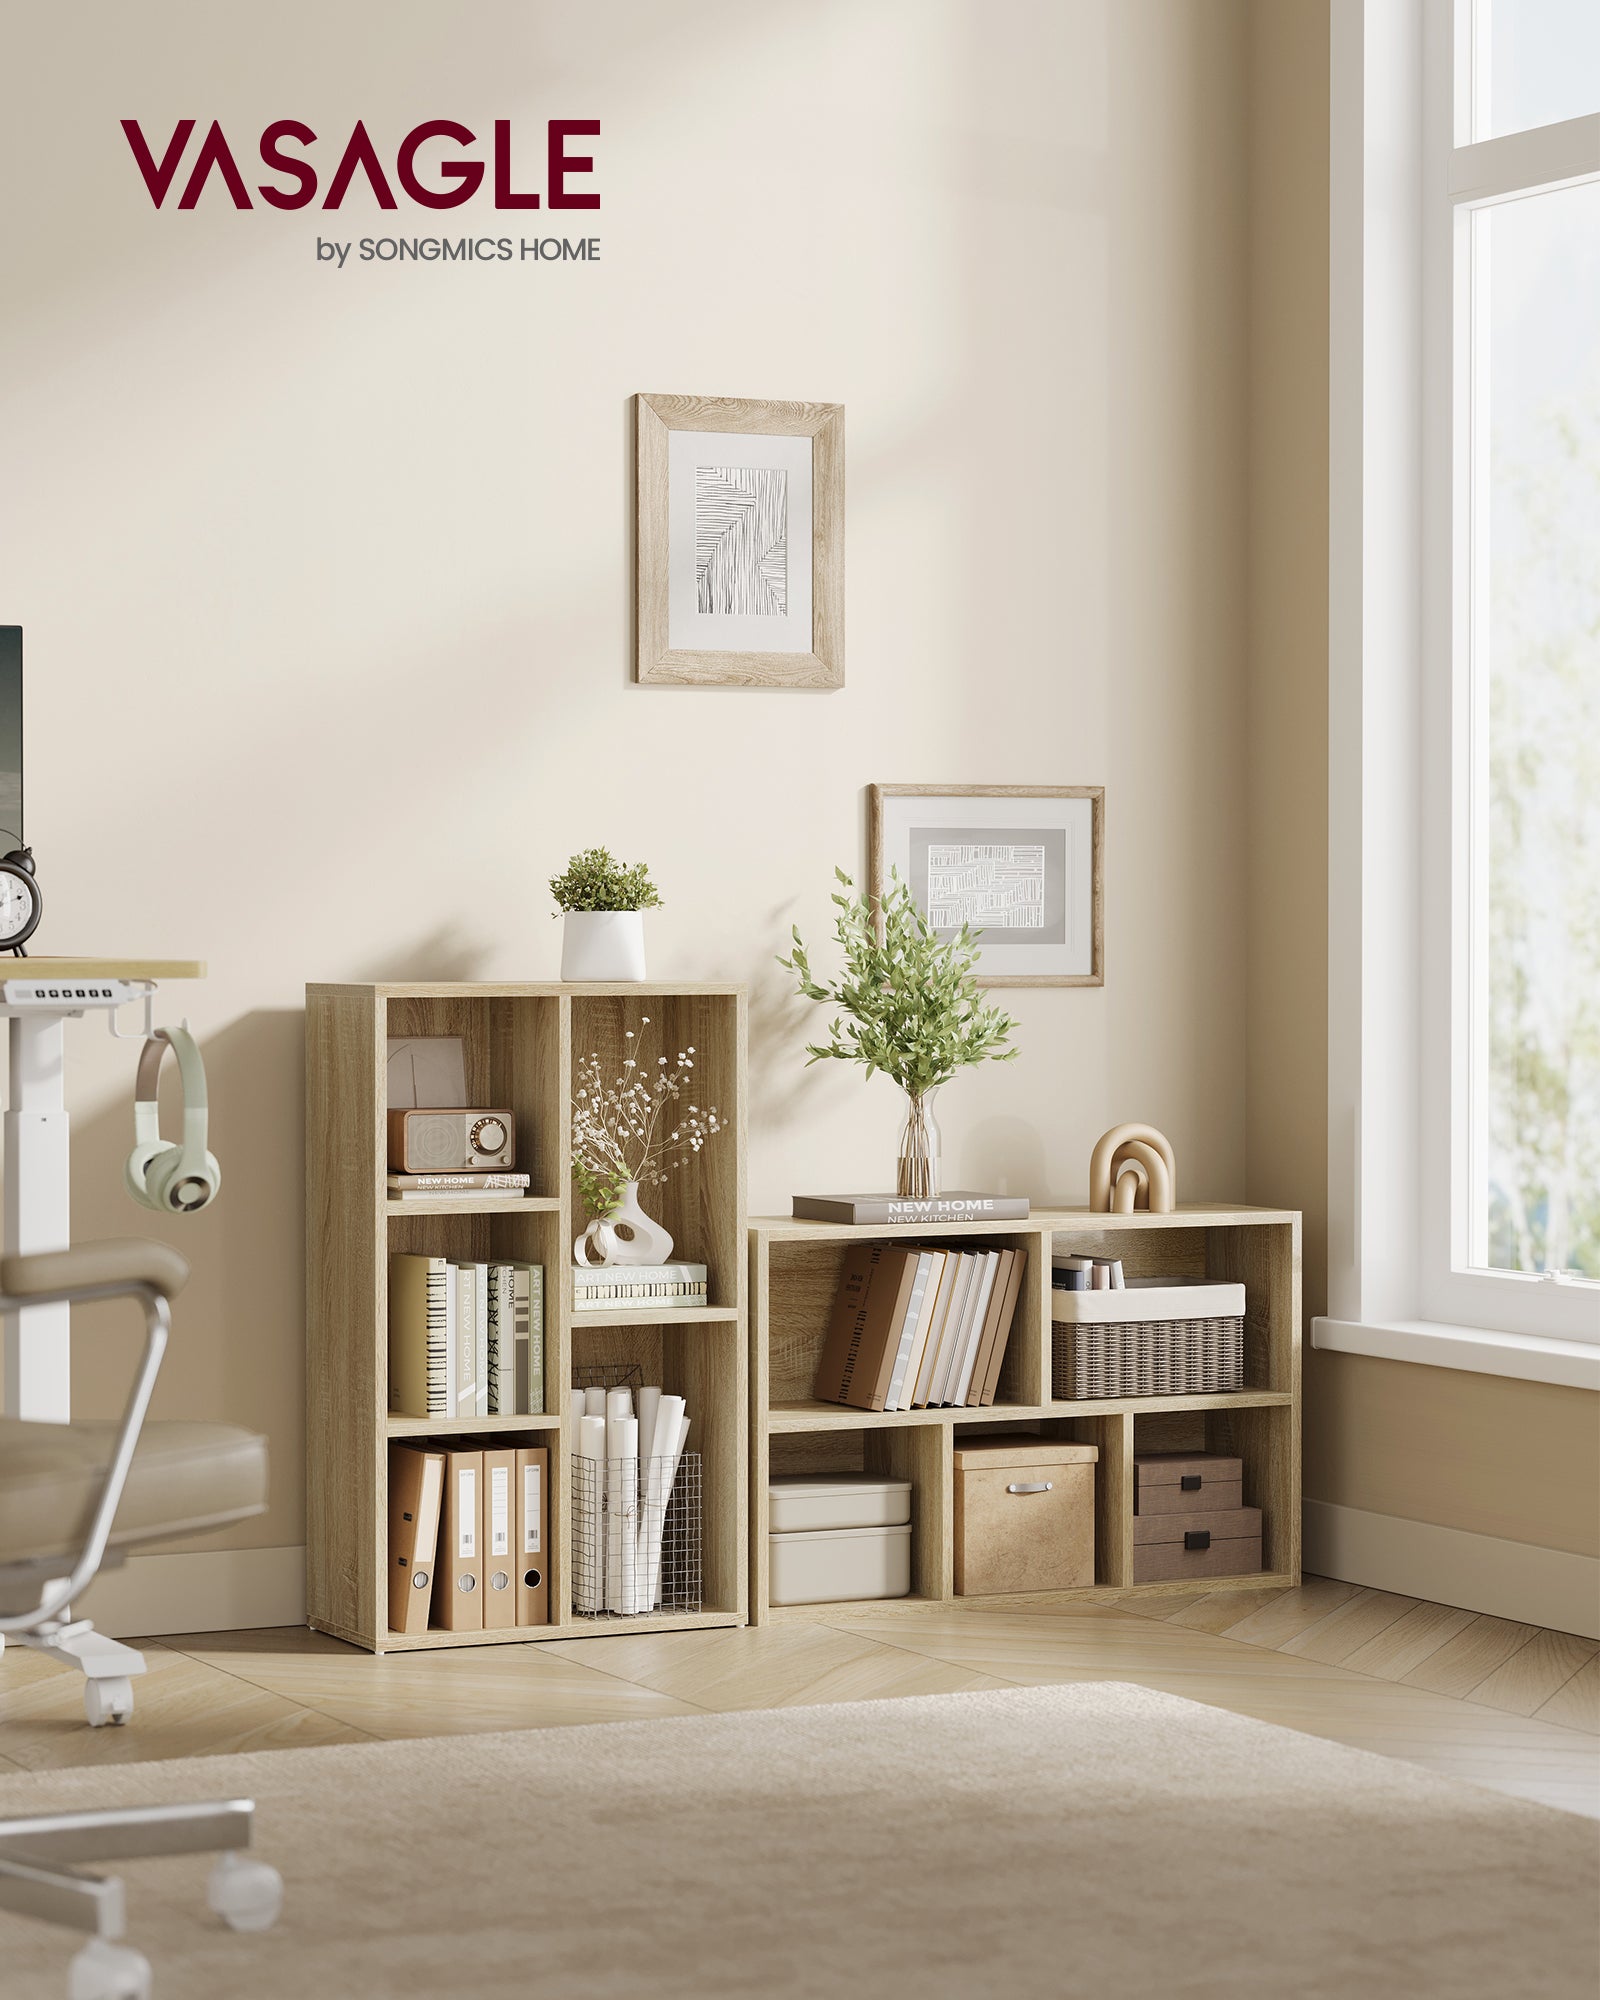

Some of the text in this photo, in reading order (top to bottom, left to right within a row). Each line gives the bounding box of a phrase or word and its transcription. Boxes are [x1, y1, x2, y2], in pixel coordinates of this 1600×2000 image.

[417, 1177, 442, 1185] NEW
[888, 1199, 994, 1213] NEW HOME
[887, 1213, 974, 1223] NEW KITCHEN
[577, 1270, 677, 1283] ART NEW HOME
